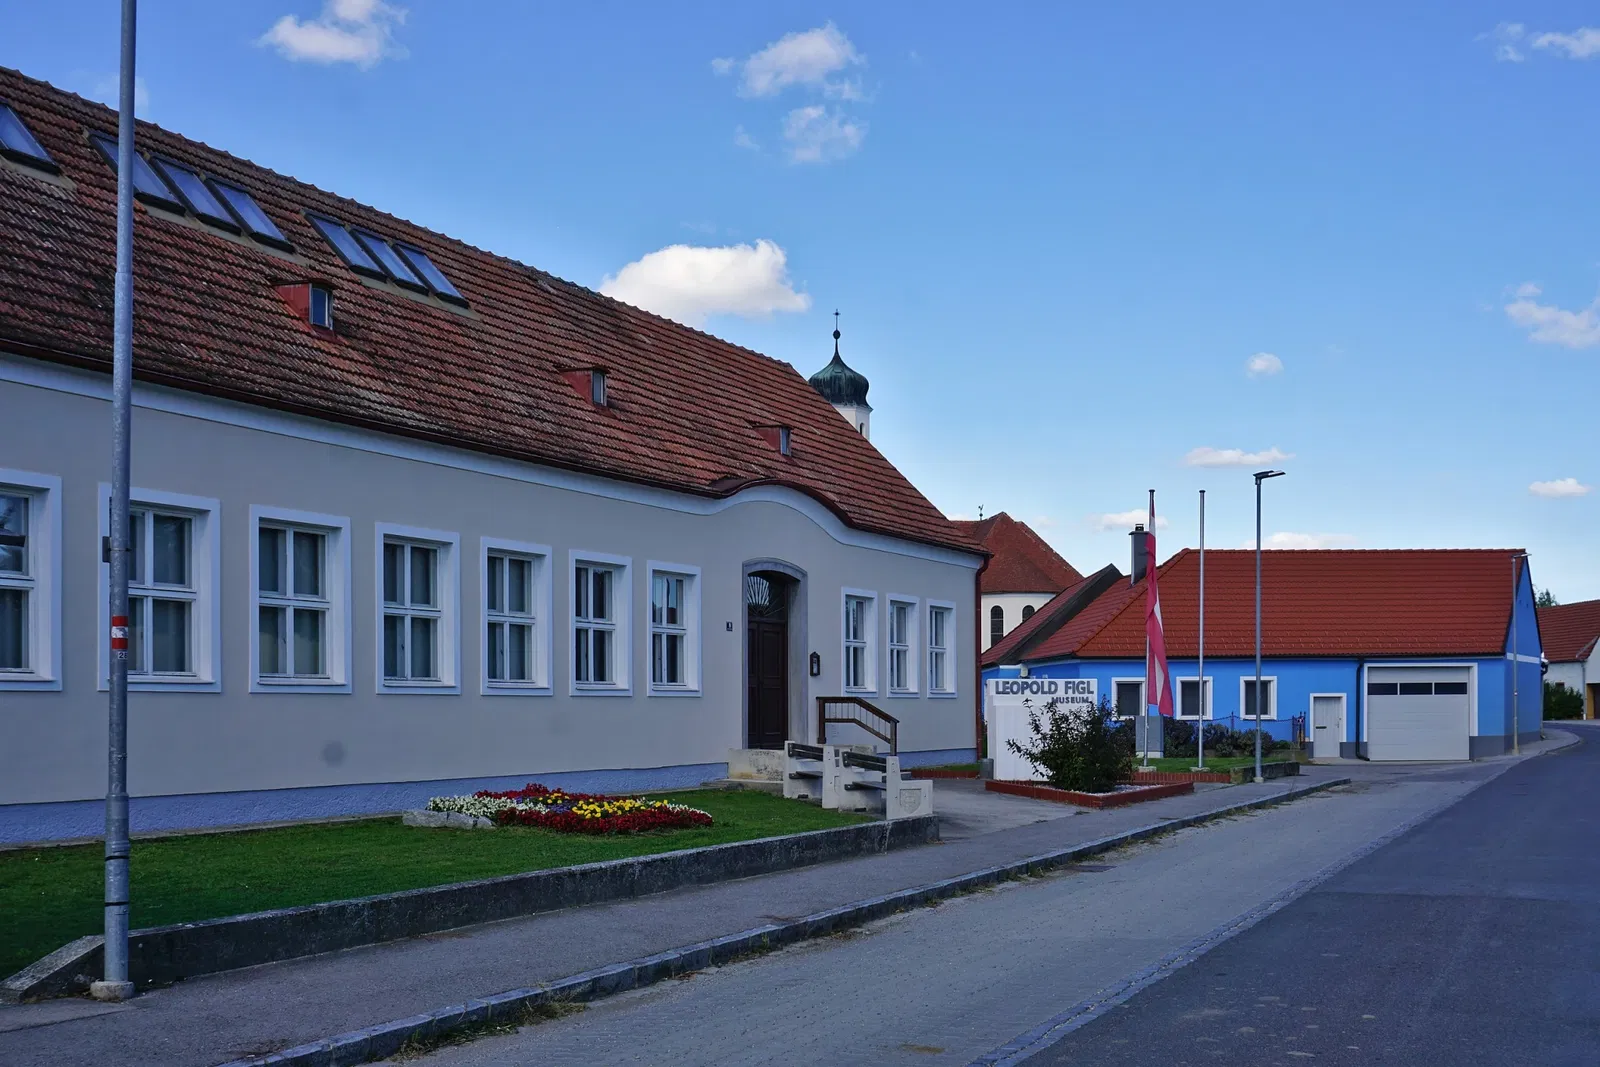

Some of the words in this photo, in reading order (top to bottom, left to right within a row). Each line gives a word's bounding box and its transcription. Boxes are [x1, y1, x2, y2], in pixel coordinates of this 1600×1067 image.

[995, 680, 1058, 695] LEOPOLD
[1064, 680, 1095, 695] FIGL
[1051, 696, 1090, 704] MUSEUM
